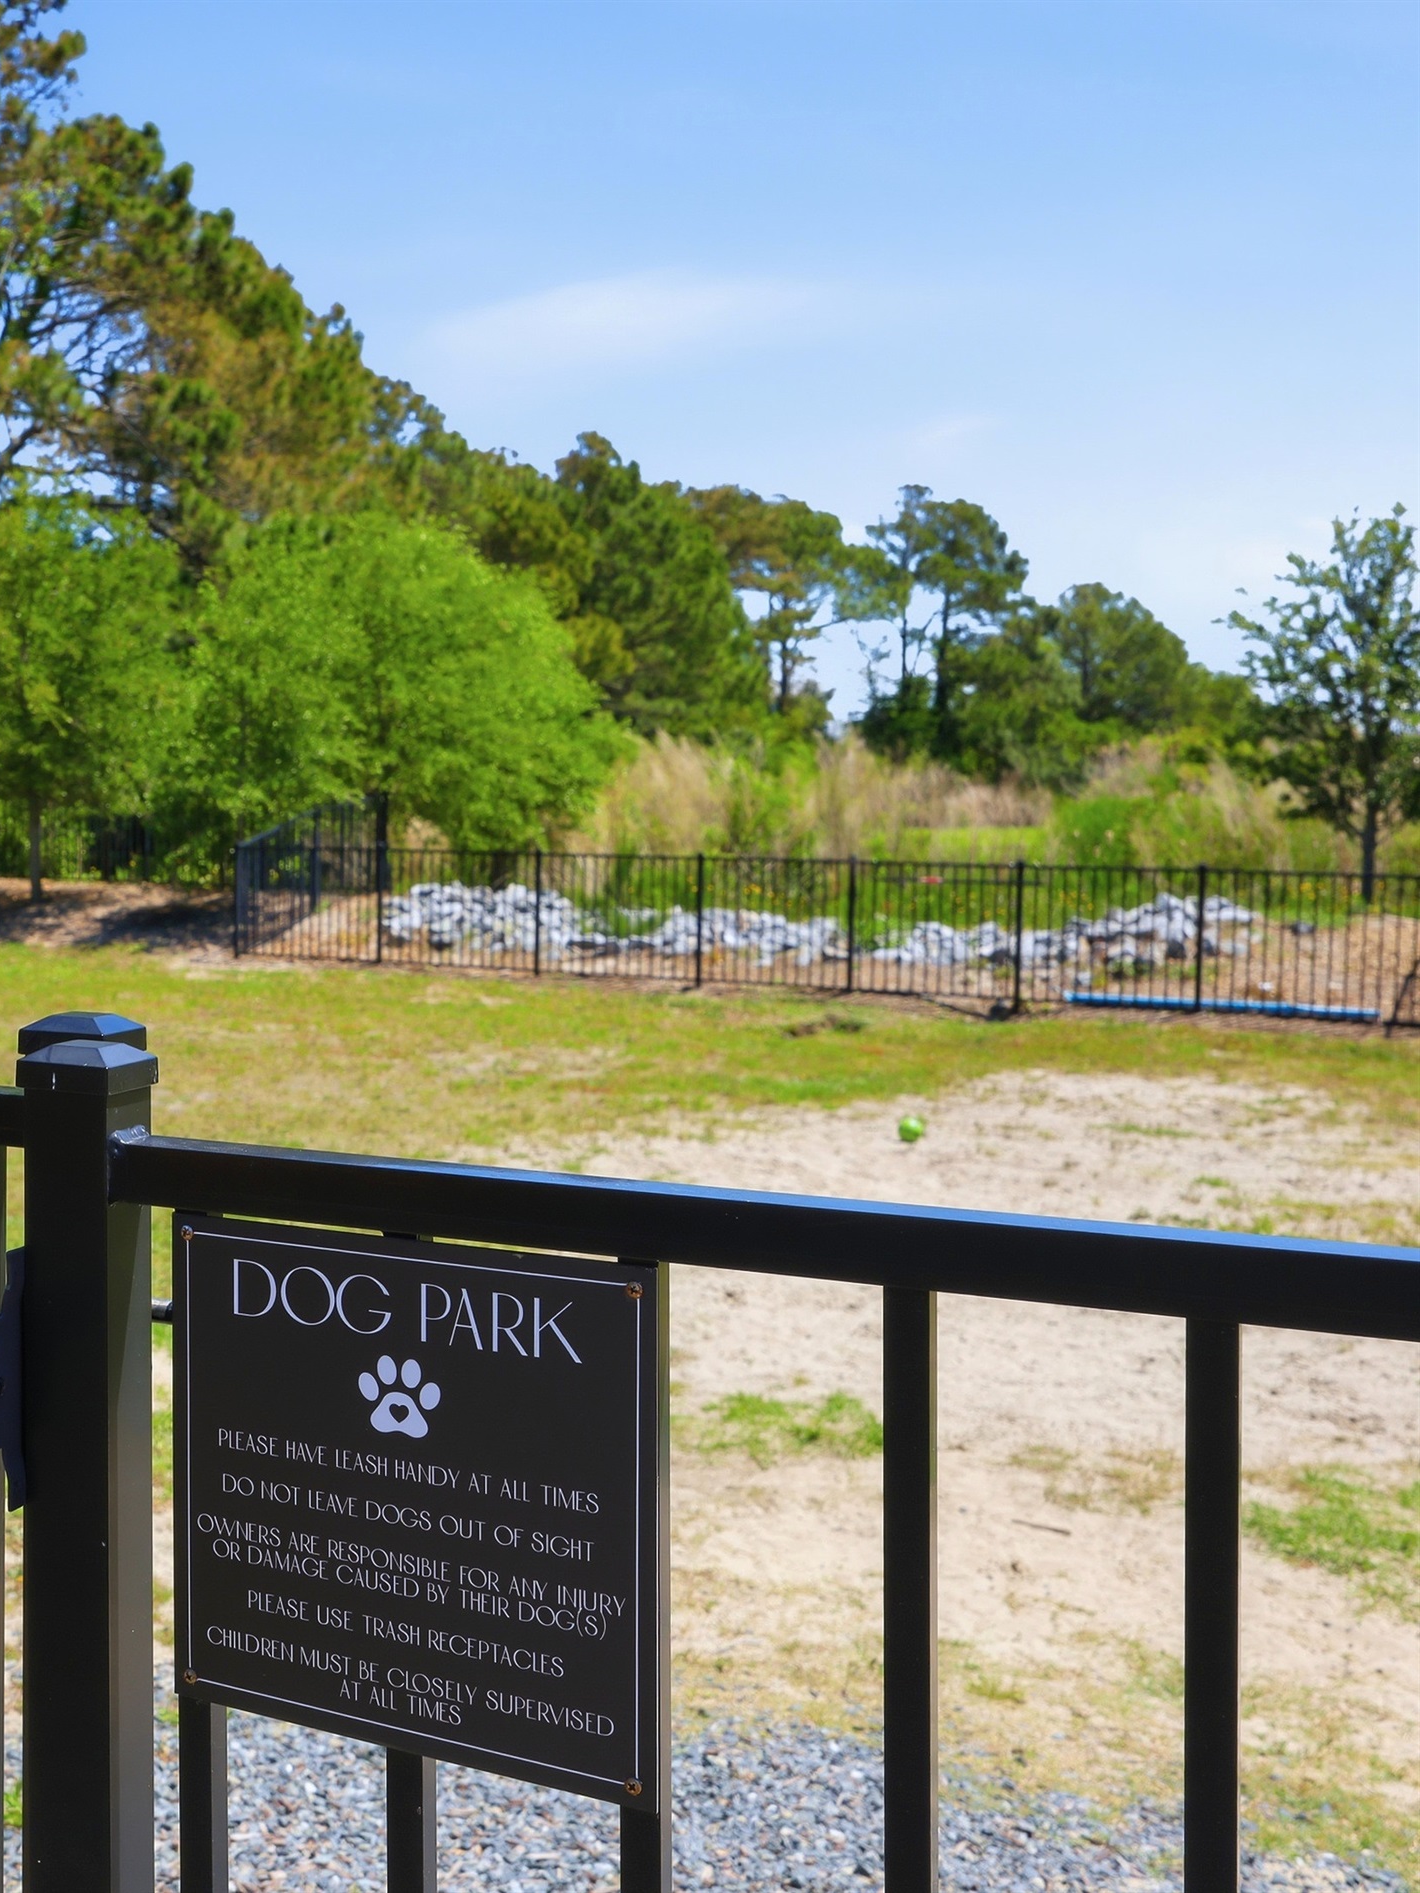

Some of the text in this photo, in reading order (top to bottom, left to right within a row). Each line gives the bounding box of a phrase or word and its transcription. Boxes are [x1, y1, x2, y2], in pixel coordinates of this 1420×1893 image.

[234, 1259, 582, 1363] DOG PARK
[219, 1429, 599, 1513] PLEASE HAVE LEASH HANDY AT ALL TIMES
[223, 1474, 593, 1561] DO NOT LEAVE DOGS OUT OF SIGHT
[198, 1514, 625, 1618] OWNERS ARE RESPONSIBLE FOR ANY INJURY
[213, 1539, 607, 1640] OR DAMAGE CAUSED BY THEIR DOG(S)
[249, 1590, 563, 1677] PLEASE USE TRASH RECEPTACLES
[207, 1626, 614, 1736] CHILDREN MUST BE CLOSELY SUPERVISED
[340, 1679, 461, 1725] AT ALL TIMES
